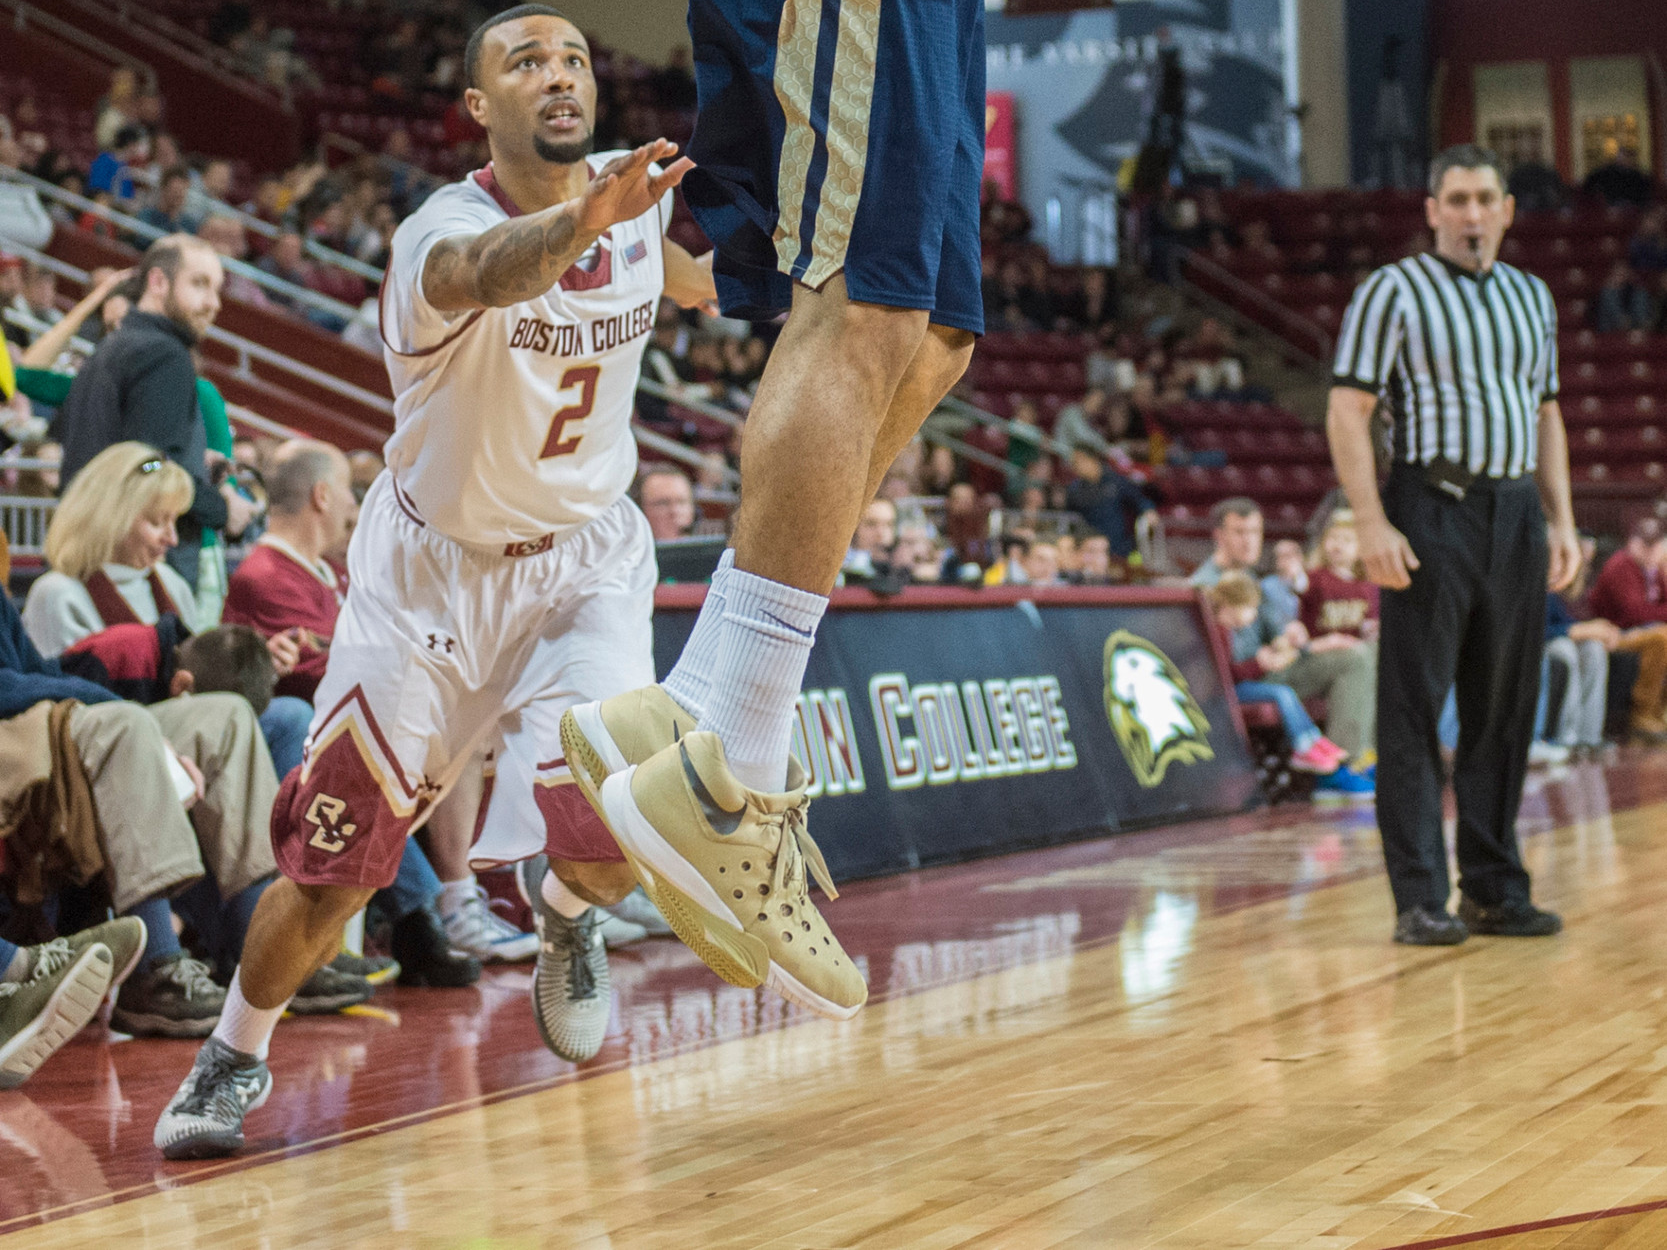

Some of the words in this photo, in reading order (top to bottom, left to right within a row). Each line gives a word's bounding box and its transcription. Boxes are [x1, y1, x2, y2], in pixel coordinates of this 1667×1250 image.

[509, 317, 585, 358] BOSTON
[592, 299, 654, 353] COLLEGE
[538, 363, 602, 461] 2
[868, 671, 1078, 790] COLLEGE
